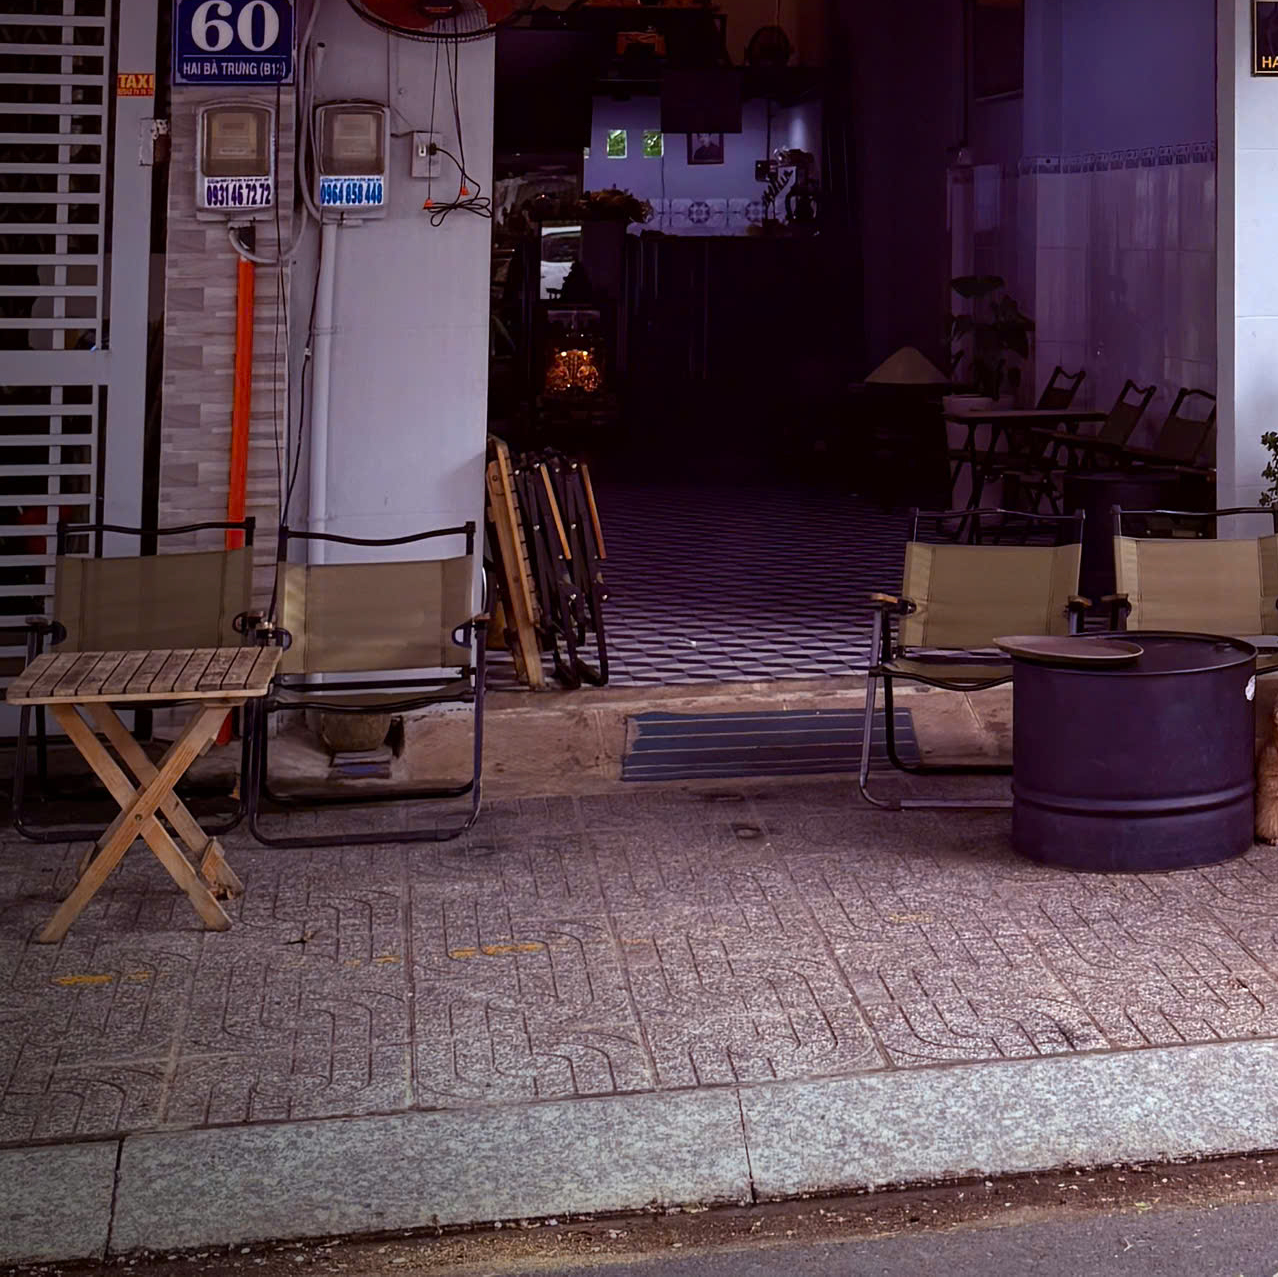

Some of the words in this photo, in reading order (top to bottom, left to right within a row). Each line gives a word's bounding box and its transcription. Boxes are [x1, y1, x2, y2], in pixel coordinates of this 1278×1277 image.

[190, 0, 280, 52] 60
[183, 62, 201, 75] HAI
[203, 59, 218, 75] BÀ
[118, 75, 154, 89] TAXI
[206, 183, 230, 206] 0931
[231, 183, 244, 206] 46
[245, 183, 258, 205] 72
[259, 183, 271, 205] 72
